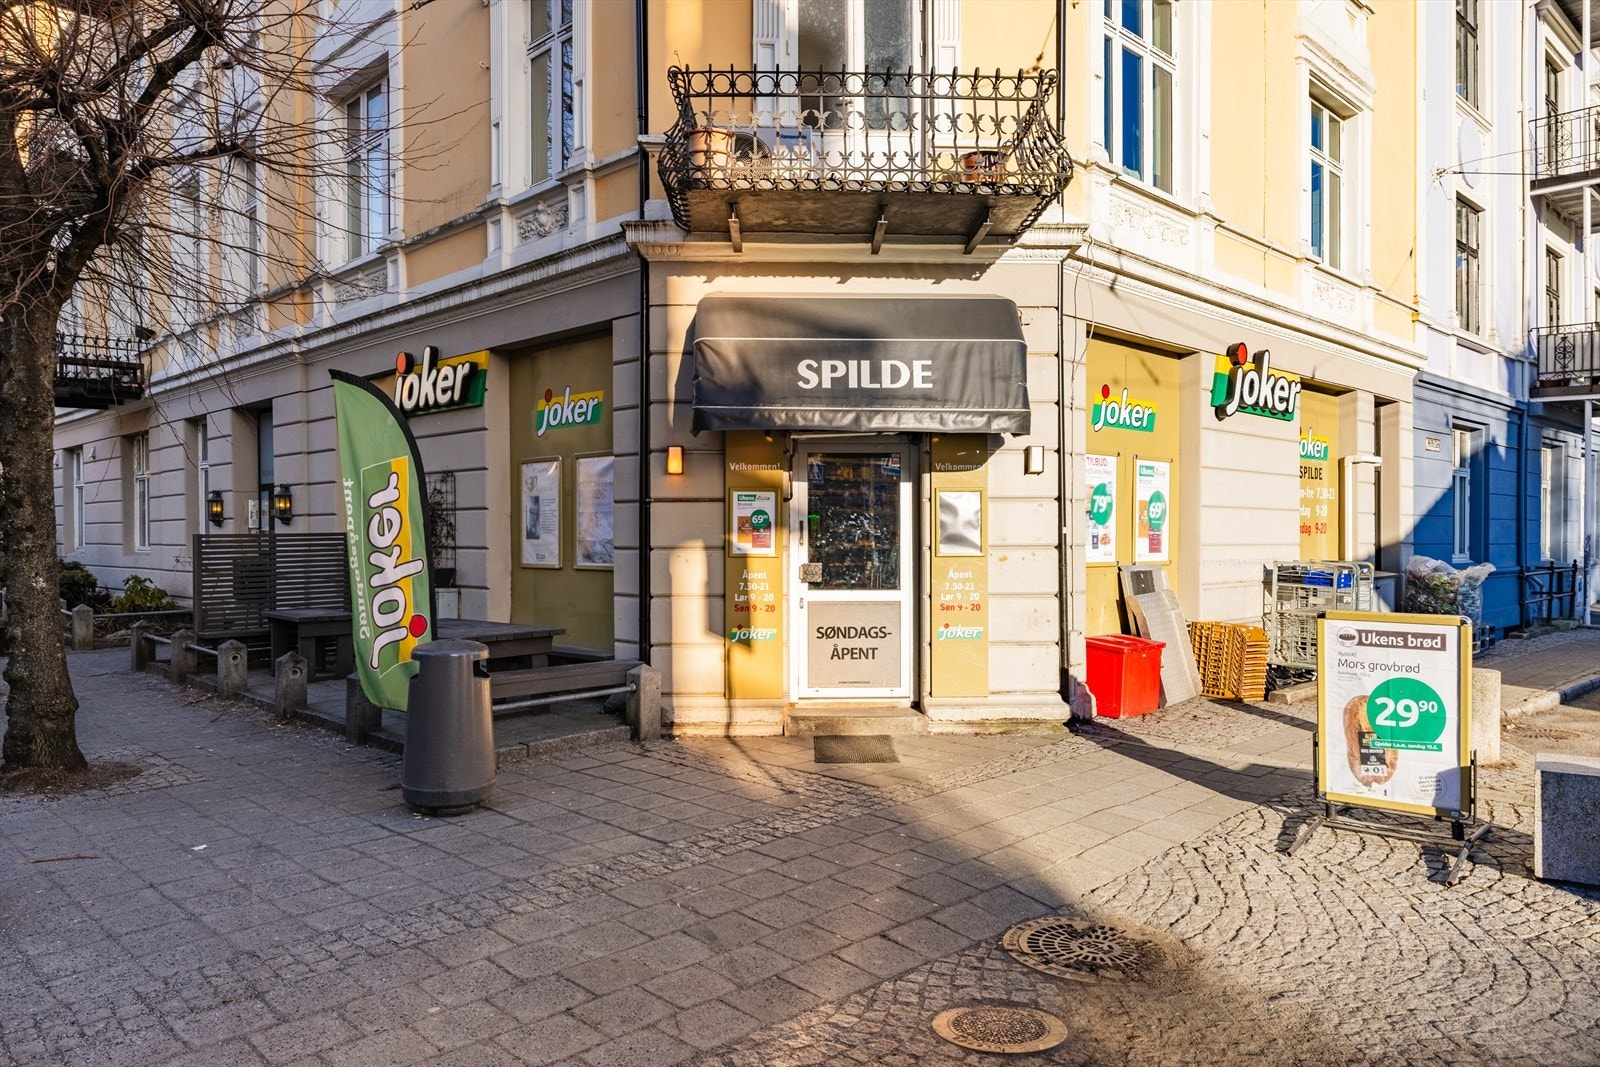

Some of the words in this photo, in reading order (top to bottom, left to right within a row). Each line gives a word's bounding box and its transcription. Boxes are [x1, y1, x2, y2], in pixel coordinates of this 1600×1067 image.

[395, 345, 477, 412] joker
[797, 359, 934, 390] SPILDE
[1222, 342, 1301, 417] joker
[537, 386, 599, 437] joker
[1093, 384, 1153, 432] joker
[1299, 427, 1327, 458] oker
[729, 462, 781, 472] Velkommen!
[1299, 466, 1323, 480] SPILDE
[742, 569, 767, 580] Åpent
[948, 569, 973, 579] Åpent
[739, 582, 769, 591] 7.30-21
[944, 582, 976, 590] 7.30-21
[734, 593, 748, 601] Lør
[750, 593, 756, 601] 9
[763, 593, 775, 601] 20
[941, 592, 954, 600] Lør
[956, 592, 961, 600] 9
[969, 592, 980, 600] 20
[734, 604, 750, 612] Søn
[752, 604, 758, 612] 9
[765, 604, 775, 612] 20
[940, 603, 955, 612] Søn
[957, 603, 963, 612] 9
[970, 603, 981, 612] 20
[731, 624, 774, 642] joker
[816, 625, 892, 640] SØNDAGS-
[938, 623, 981, 641] joker
[1361, 632, 1404, 647] Ukens
[1407, 633, 1442, 648] brød
[830, 643, 878, 660] ÅPENT
[1338, 658, 1366, 669] Mors
[1368, 661, 1420, 674] grovbrød
